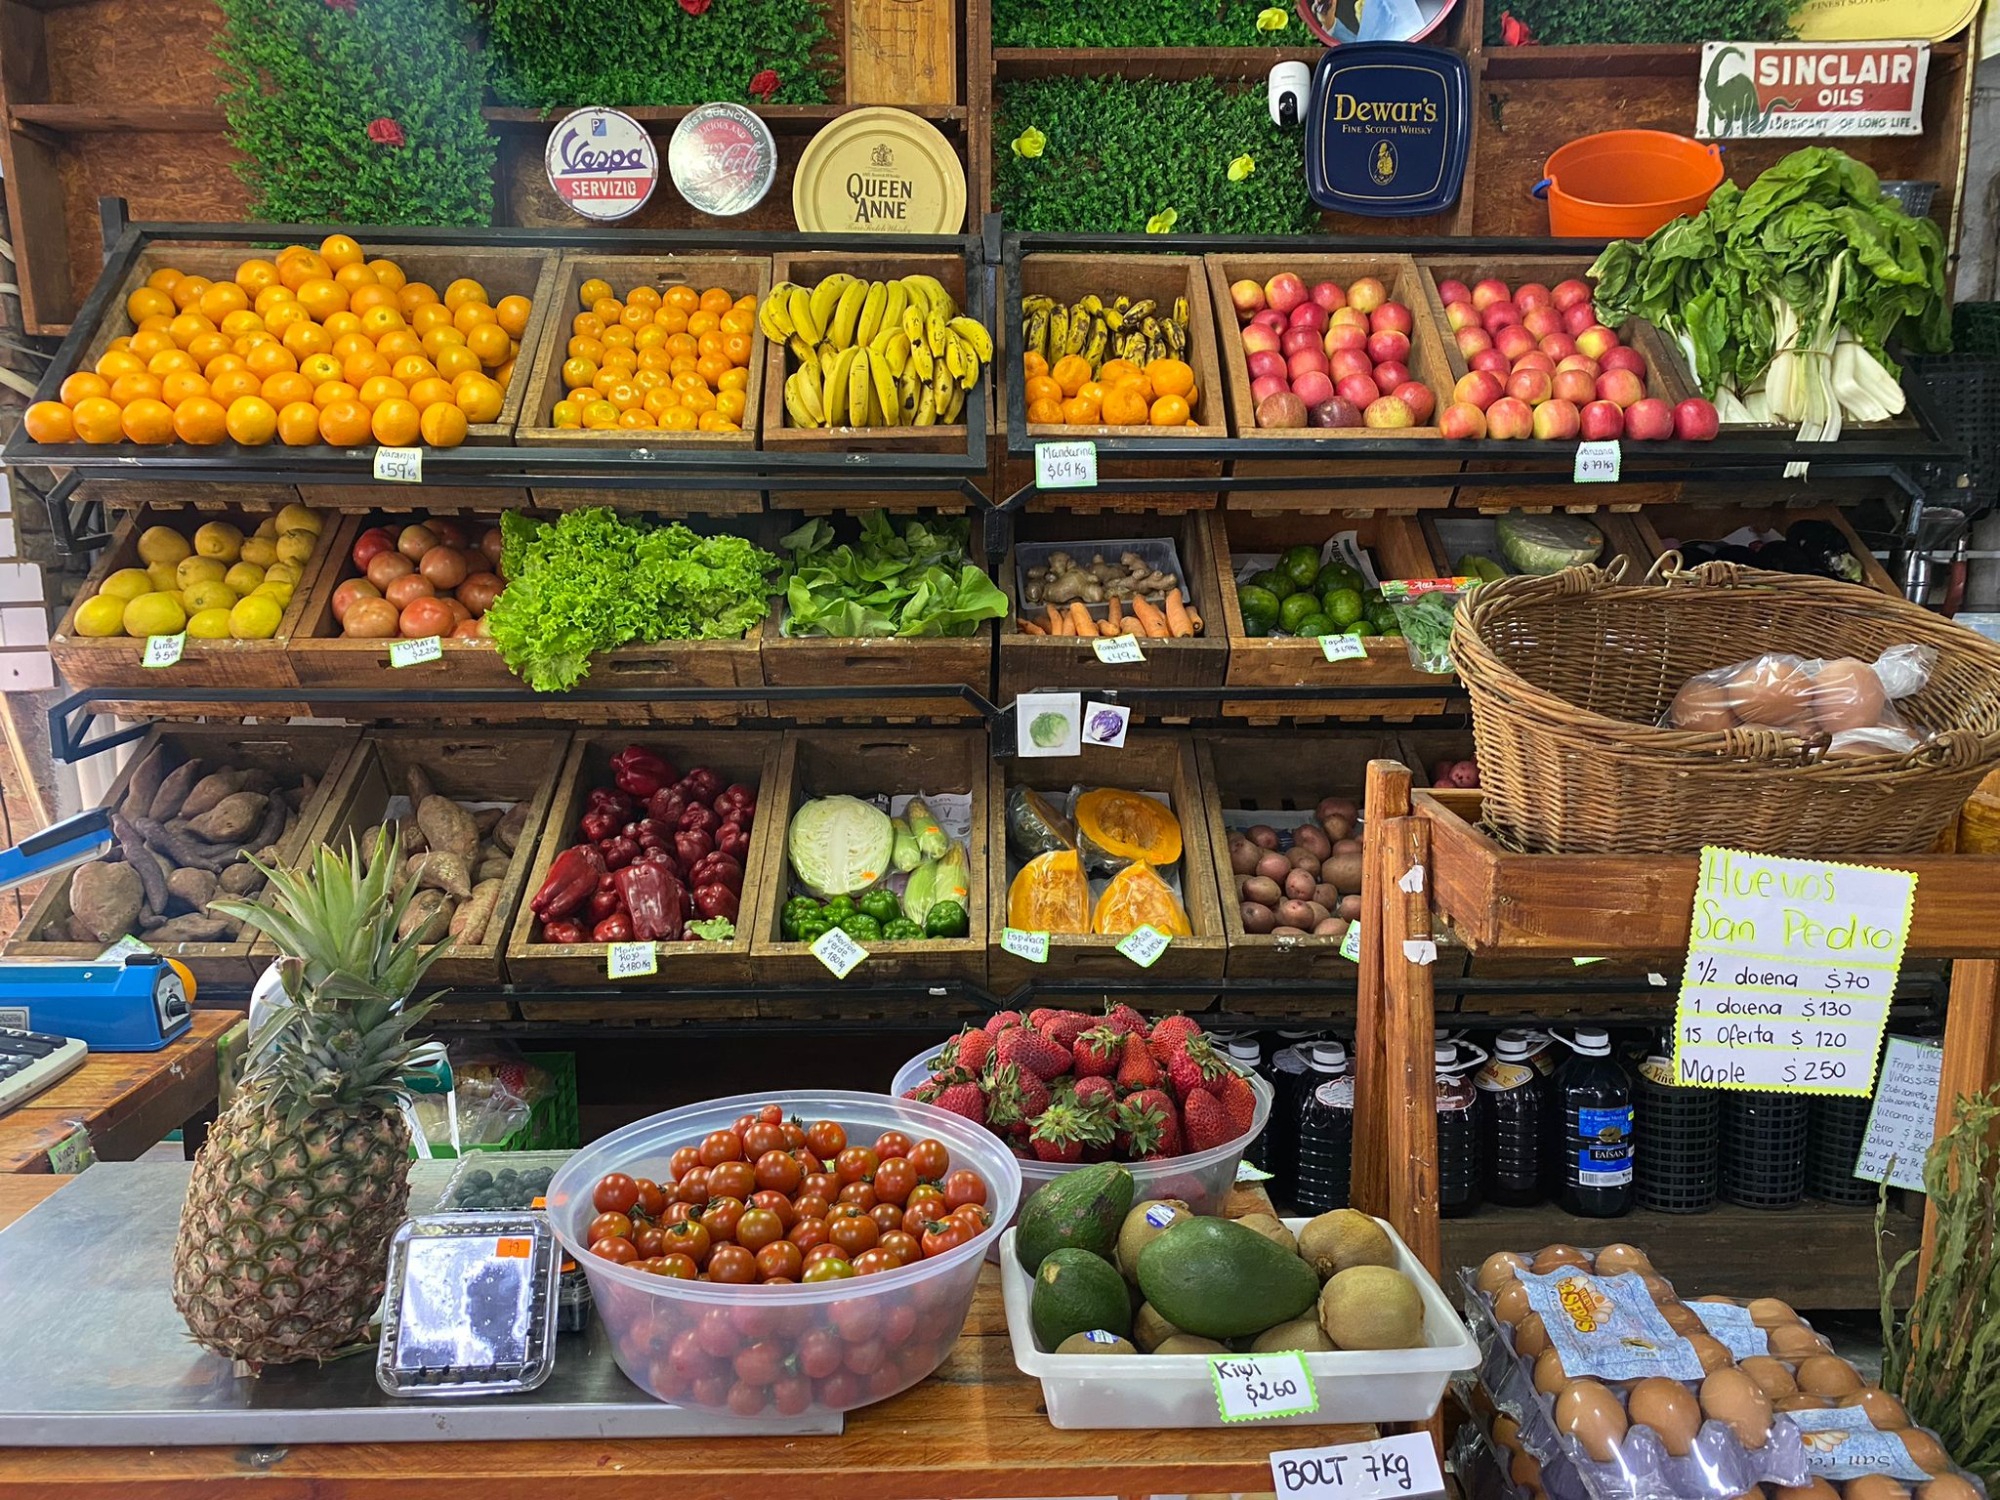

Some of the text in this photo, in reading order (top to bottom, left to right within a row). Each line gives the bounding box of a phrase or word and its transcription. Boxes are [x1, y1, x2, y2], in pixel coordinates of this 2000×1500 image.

[1759, 54, 1913, 86] SINCLAIR
[1334, 93, 1438, 122] Dewar's
[1817, 89, 1864, 106] OILS
[704, 108, 762, 138] QUENCHING
[1342, 124, 1433, 135] FINE SCOTCH WHISKY
[1858, 116, 1886, 129] LONG
[1890, 116, 1912, 128] LIFE
[560, 128, 648, 175] Vespa
[571, 180, 637, 197] SERVIZIO
[846, 172, 913, 204] QUEEN
[855, 197, 906, 223] ANNE
[1043, 446, 1094, 459] Mandarina
[1048, 462, 1071, 480] $69
[1706, 855, 1836, 902] Huevos
[1696, 899, 1893, 950] San Pedro
[1698, 957, 1719, 985] 1/2
[1825, 968, 1870, 994] $70
[1694, 999, 1701, 1013] 1
[1802, 998, 1851, 1021] $130
[1684, 1027, 1702, 1044] 15
[1717, 1024, 1774, 1048] Oferta
[1681, 1059, 1746, 1087] Maple
[1213, 1358, 1262, 1379] Kiwi
[1246, 1377, 1297, 1407] $260
[1278, 1455, 1348, 1491] BOLT
